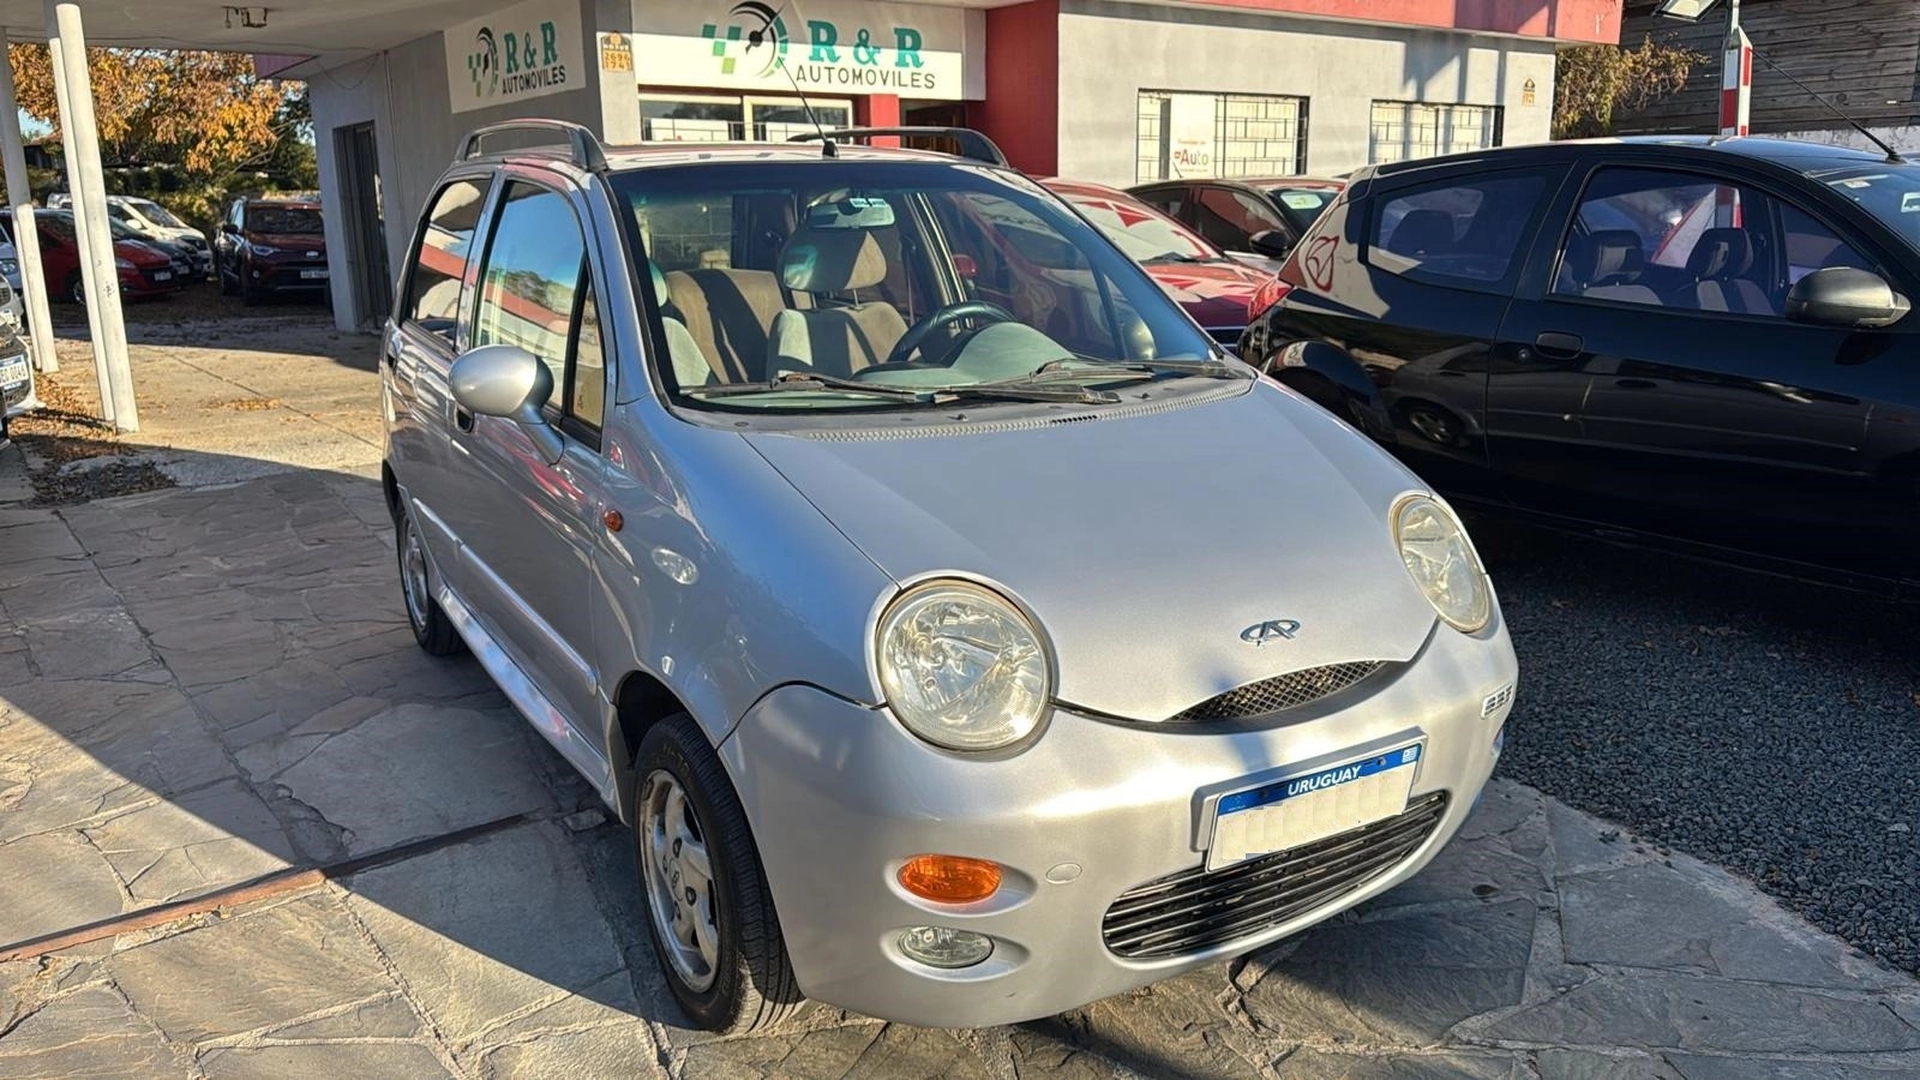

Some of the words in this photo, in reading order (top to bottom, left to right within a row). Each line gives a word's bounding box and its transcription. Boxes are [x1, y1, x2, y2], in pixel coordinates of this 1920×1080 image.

[504, 32, 520, 74] R
[524, 32, 537, 69] &
[541, 21, 558, 66] R
[807, 20, 841, 62] R
[853, 28, 881, 66] &
[894, 27, 924, 68] R
[502, 65, 566, 95] AUTOMOVILES
[796, 64, 936, 90] AUTOMOVILES
[1287, 766, 1362, 796] URUGUAY
